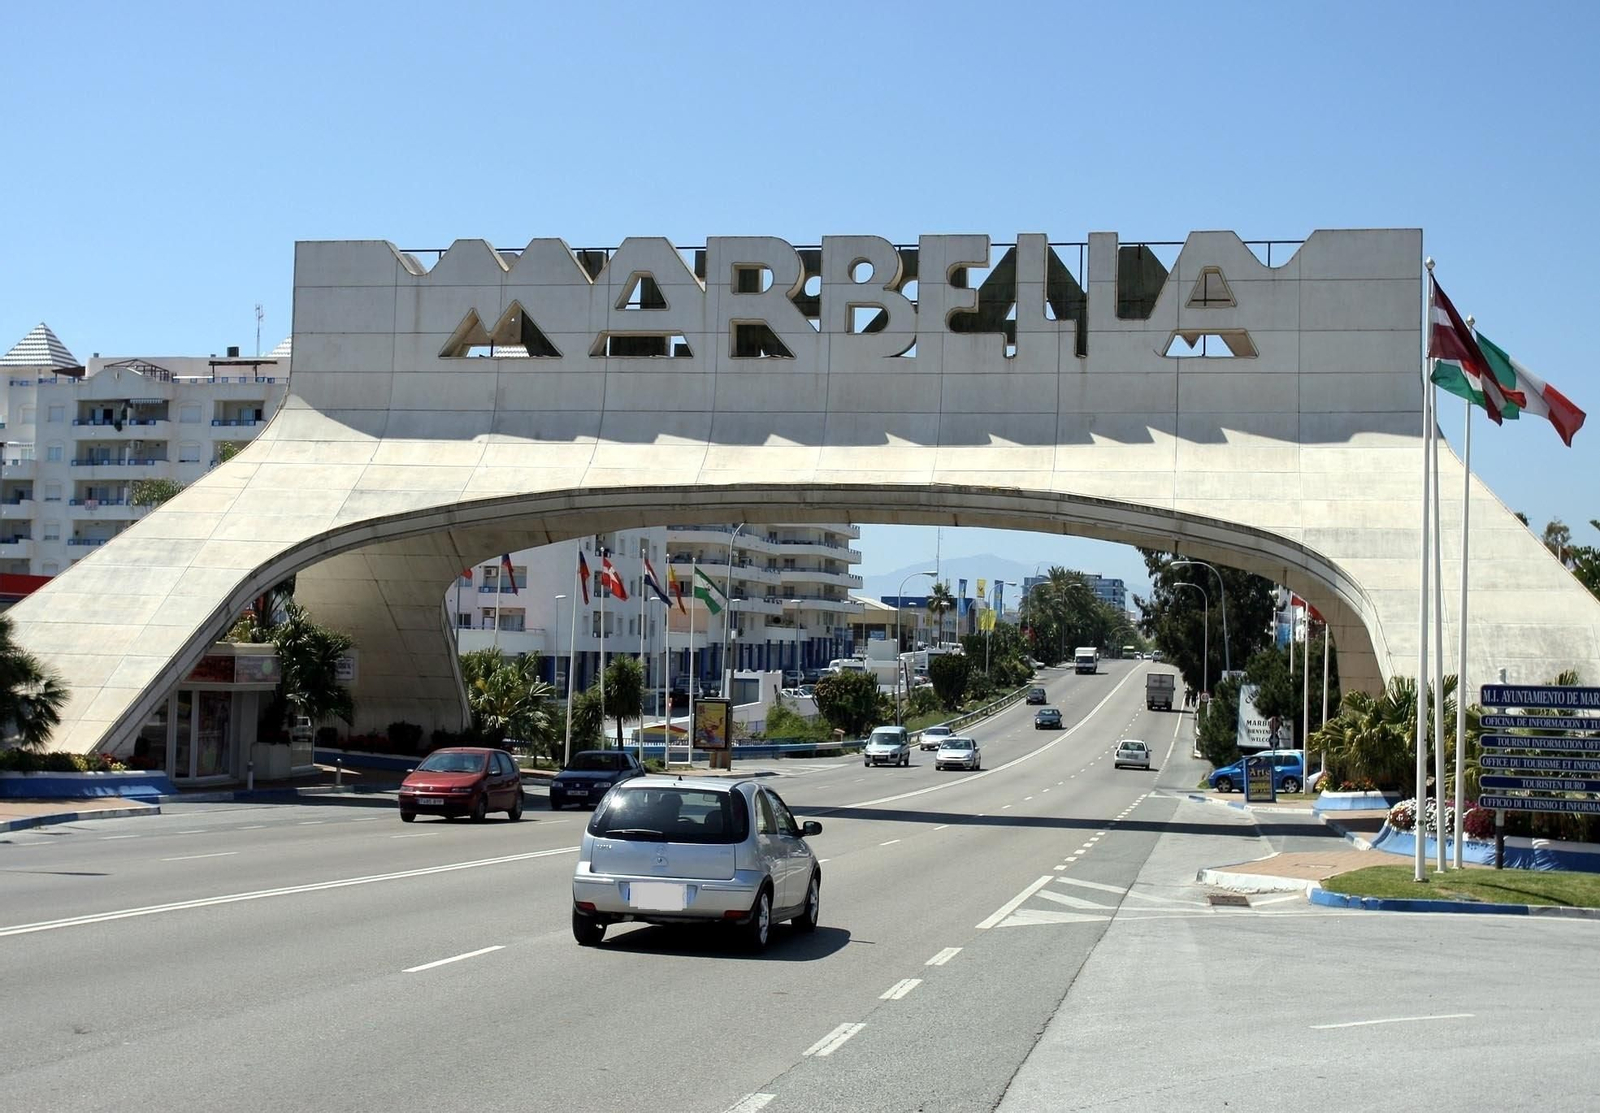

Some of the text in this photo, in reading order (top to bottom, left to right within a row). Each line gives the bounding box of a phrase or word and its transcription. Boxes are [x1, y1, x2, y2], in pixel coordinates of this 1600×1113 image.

[400, 230, 1296, 359] MARBELLA
[1501, 690, 1565, 704] AYUNTAMIENTO
[1567, 692, 1579, 705] DE
[1485, 717, 1515, 726] OFICINA
[1517, 718, 1528, 727] DE
[1582, 720, 1589, 729] Y
[1497, 738, 1530, 747] TOURISM
[1531, 739, 1583, 749] INFORMATION
[1482, 758, 1509, 767] OFFICE
[1510, 759, 1521, 767] DU
[1523, 759, 1560, 768] TOURISME
[1562, 761, 1573, 769] ET
[1521, 779, 1586, 790] TOURISTEN BURO
[1483, 799, 1513, 808] UFFICIO
[1514, 800, 1521, 808] DI
[1524, 800, 1558, 809] TURISMO
[1559, 801, 1566, 809] E
